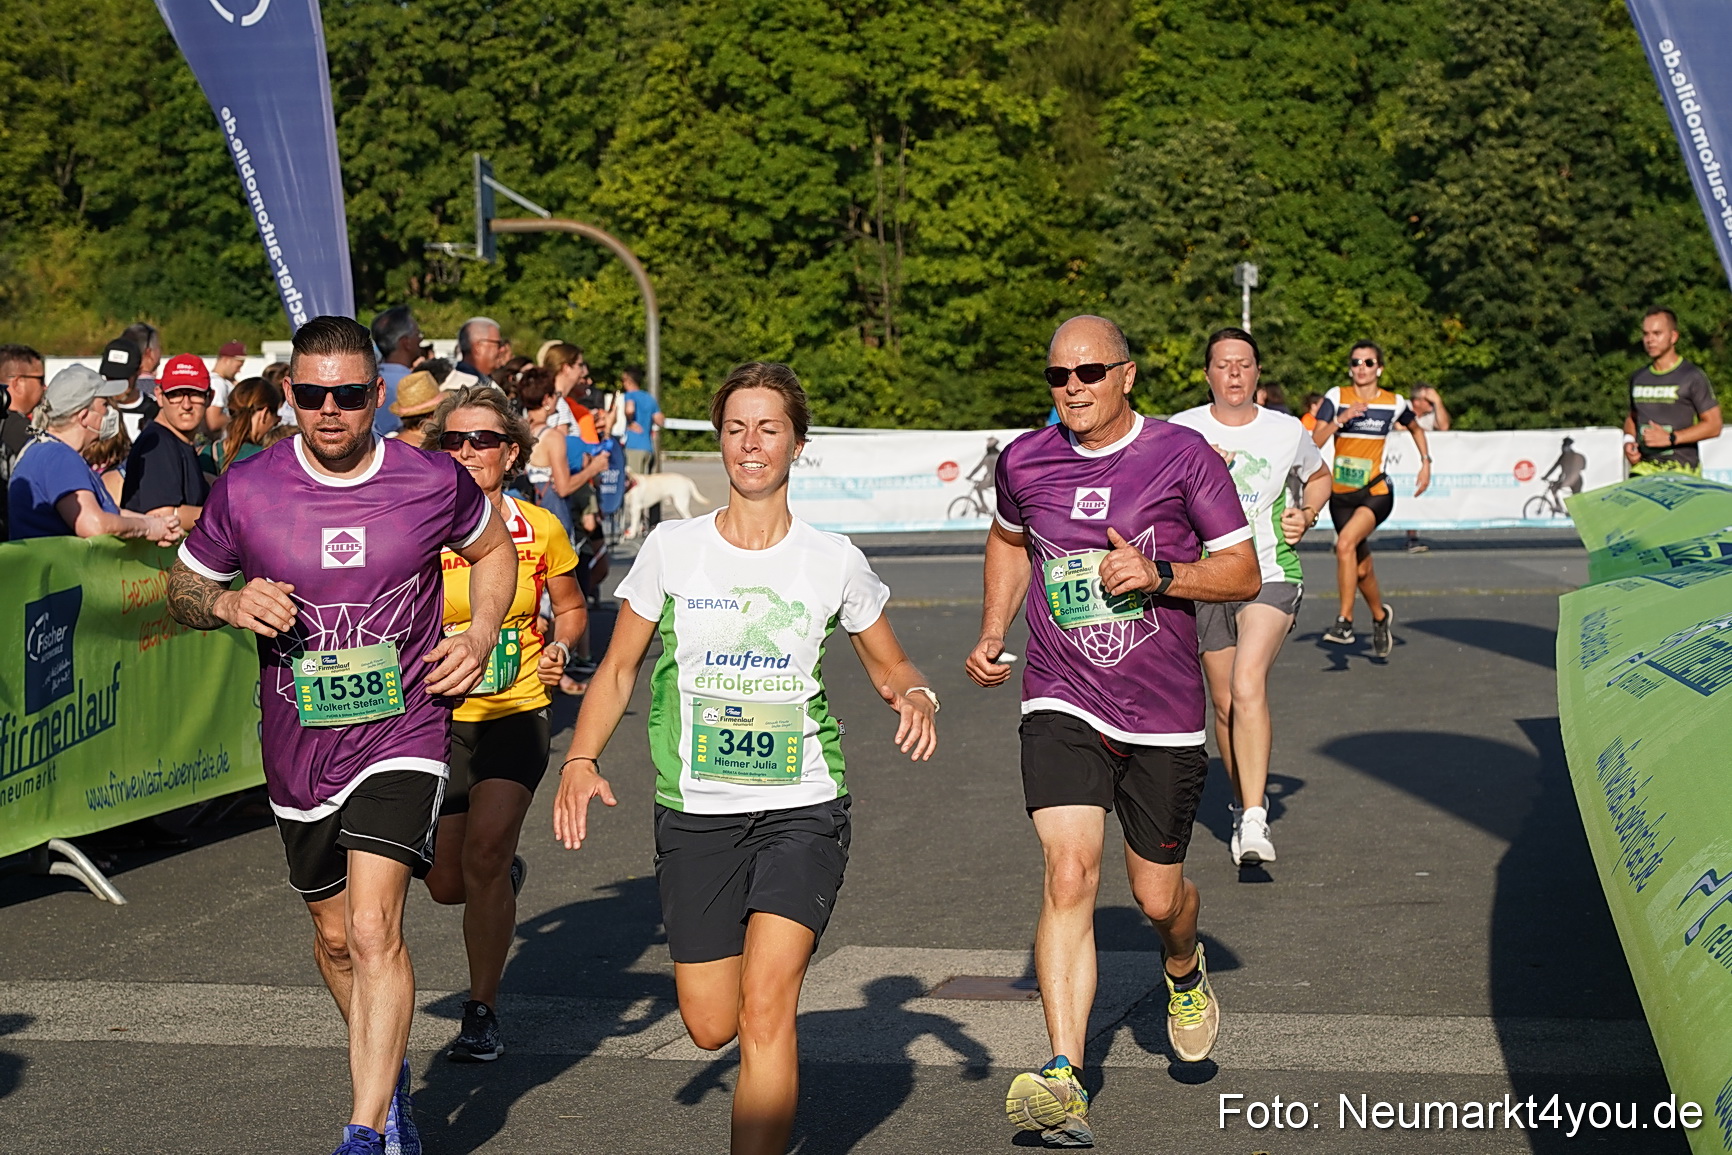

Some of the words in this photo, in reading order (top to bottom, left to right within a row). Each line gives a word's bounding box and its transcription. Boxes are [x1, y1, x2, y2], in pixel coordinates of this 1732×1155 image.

[442, 556, 472, 571] MA
[687, 599, 739, 610] BERATA
[1060, 604, 1090, 616] Schmid
[37, 625, 68, 655] Fischer
[318, 662, 350, 672] Firmenlauf
[705, 651, 791, 670] Laufend
[313, 671, 384, 701] 1538
[385, 671, 399, 705] 2022
[694, 673, 804, 695] erfolgreich
[301, 685, 313, 711] RUN
[316, 702, 351, 712] Volkert
[353, 697, 385, 710] Stefan
[697, 735, 708, 763] RUN
[718, 729, 775, 758] 349
[786, 736, 798, 773] 2022
[714, 756, 750, 767] Hiemer
[752, 760, 777, 770] Julia
